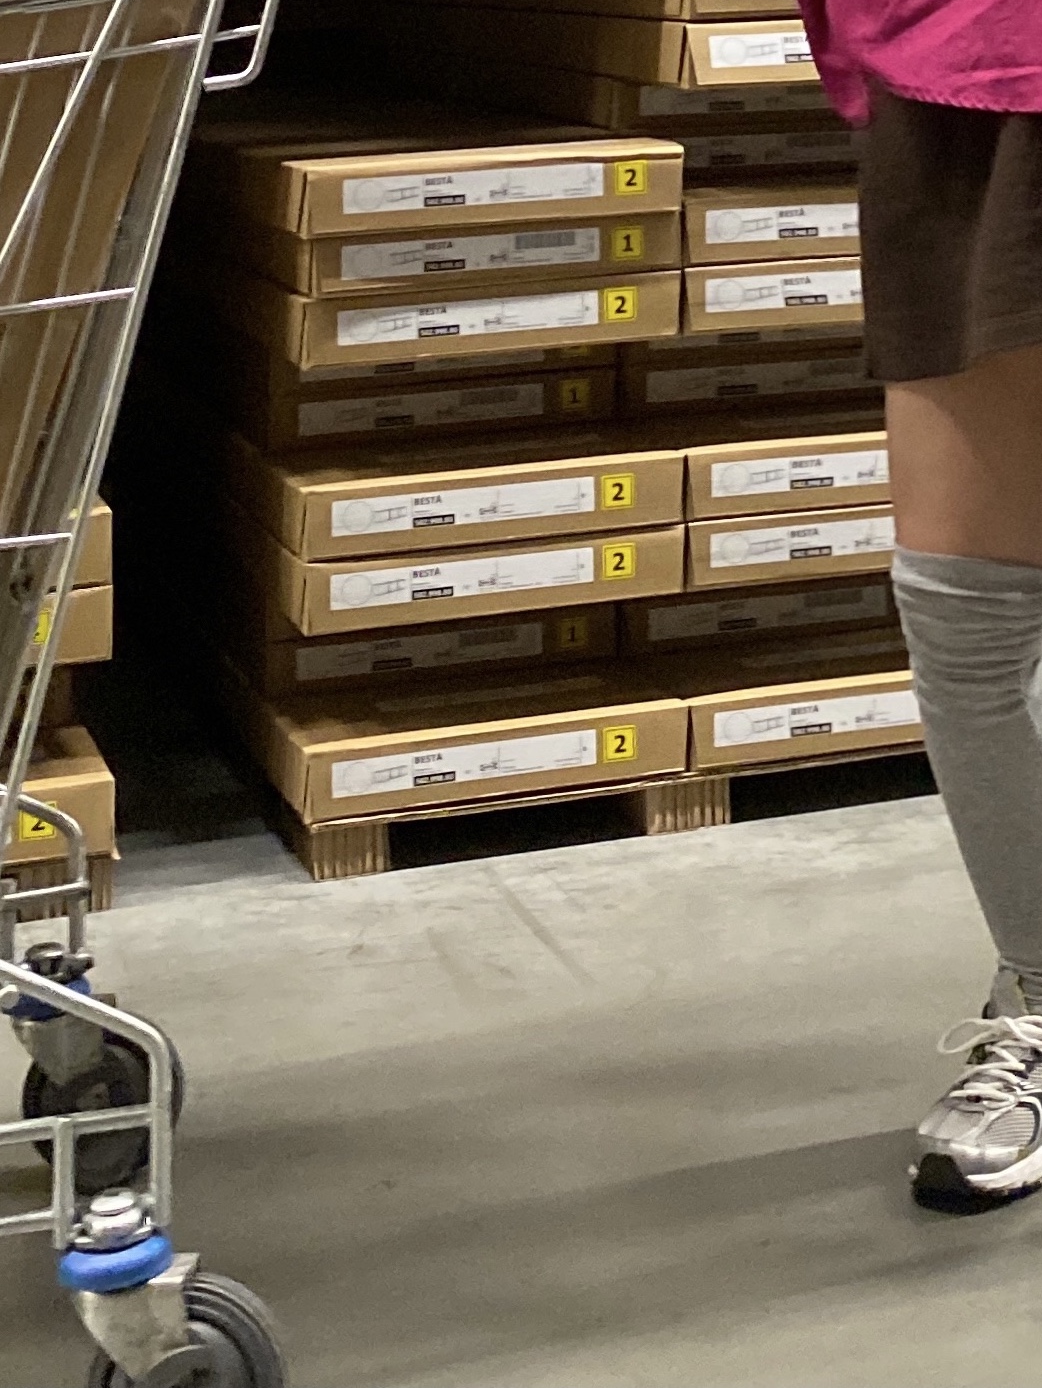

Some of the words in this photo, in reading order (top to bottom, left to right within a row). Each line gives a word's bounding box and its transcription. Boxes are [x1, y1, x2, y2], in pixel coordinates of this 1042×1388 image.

[624, 168, 637, 187] 2
[622, 234, 633, 252] 1
[614, 296, 627, 314] 2
[611, 482, 625, 502] 2
[612, 552, 625, 571] 2
[614, 734, 627, 753] 2
